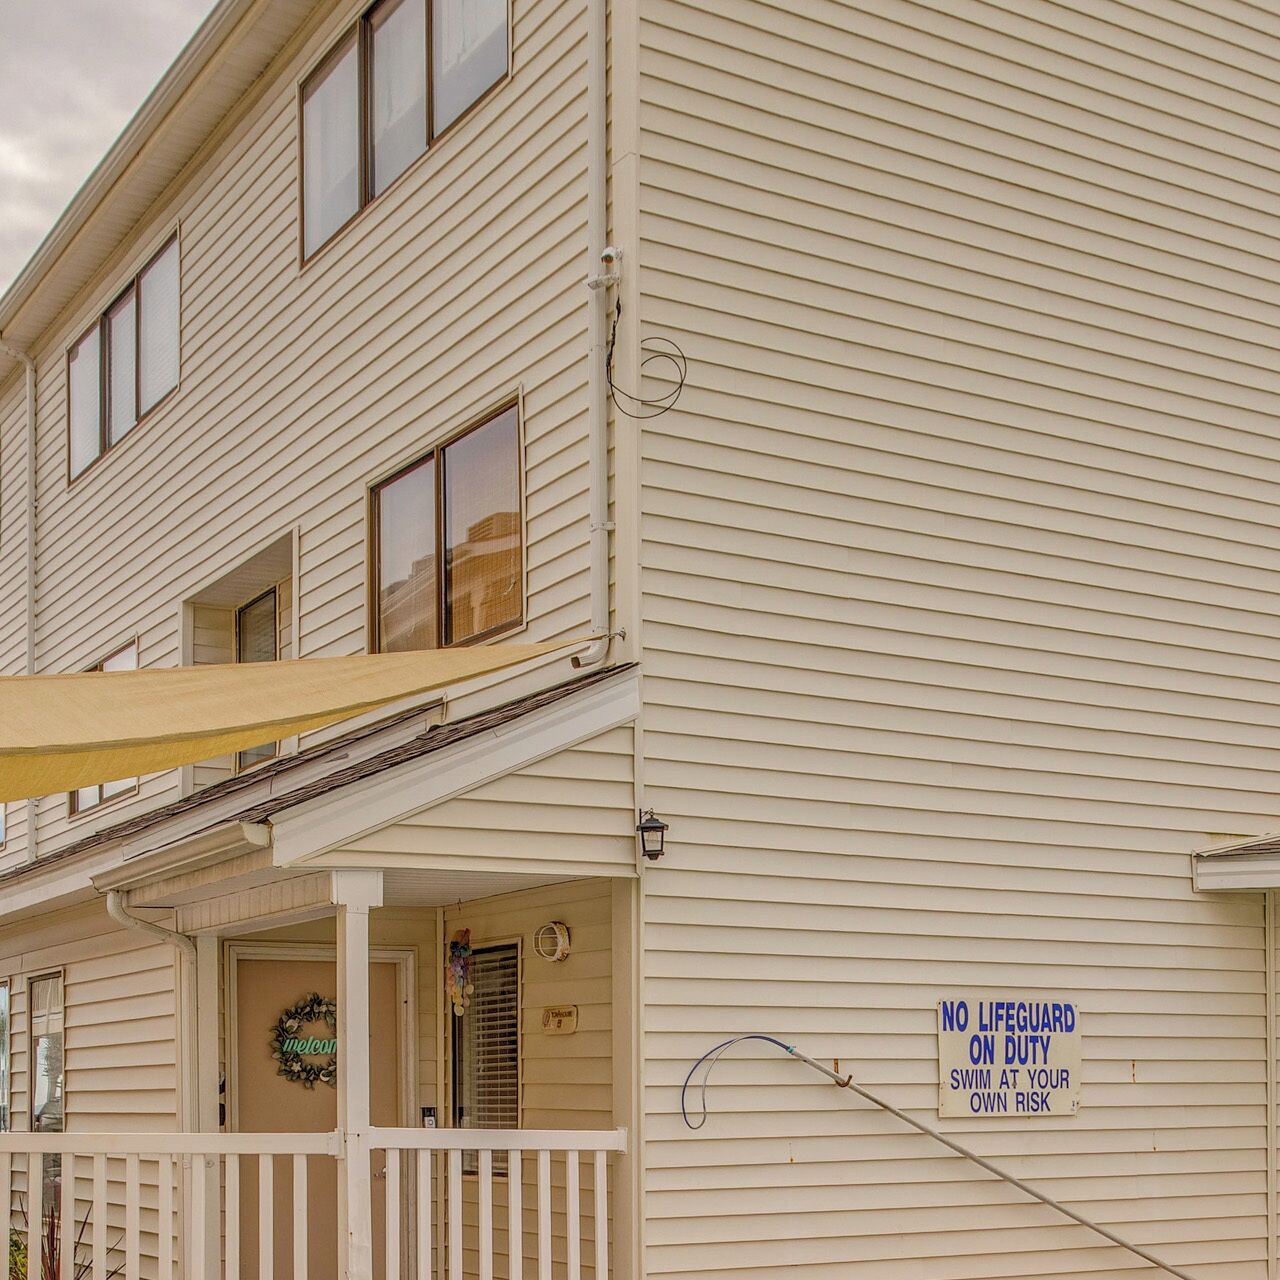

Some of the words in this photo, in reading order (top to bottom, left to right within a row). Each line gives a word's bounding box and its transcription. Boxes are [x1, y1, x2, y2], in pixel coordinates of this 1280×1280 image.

[942, 1001, 969, 1032] NO
[979, 1002, 1075, 1032] LIFEGUARD
[969, 1034, 995, 1065] ON
[1005, 1035, 1051, 1065] DUTY
[950, 1069, 991, 1090] SWIM
[999, 1069, 1019, 1089] AT
[1027, 1069, 1070, 1089] YOUR
[970, 1092, 1007, 1113] OWN
[1016, 1091, 1051, 1112] RISK
